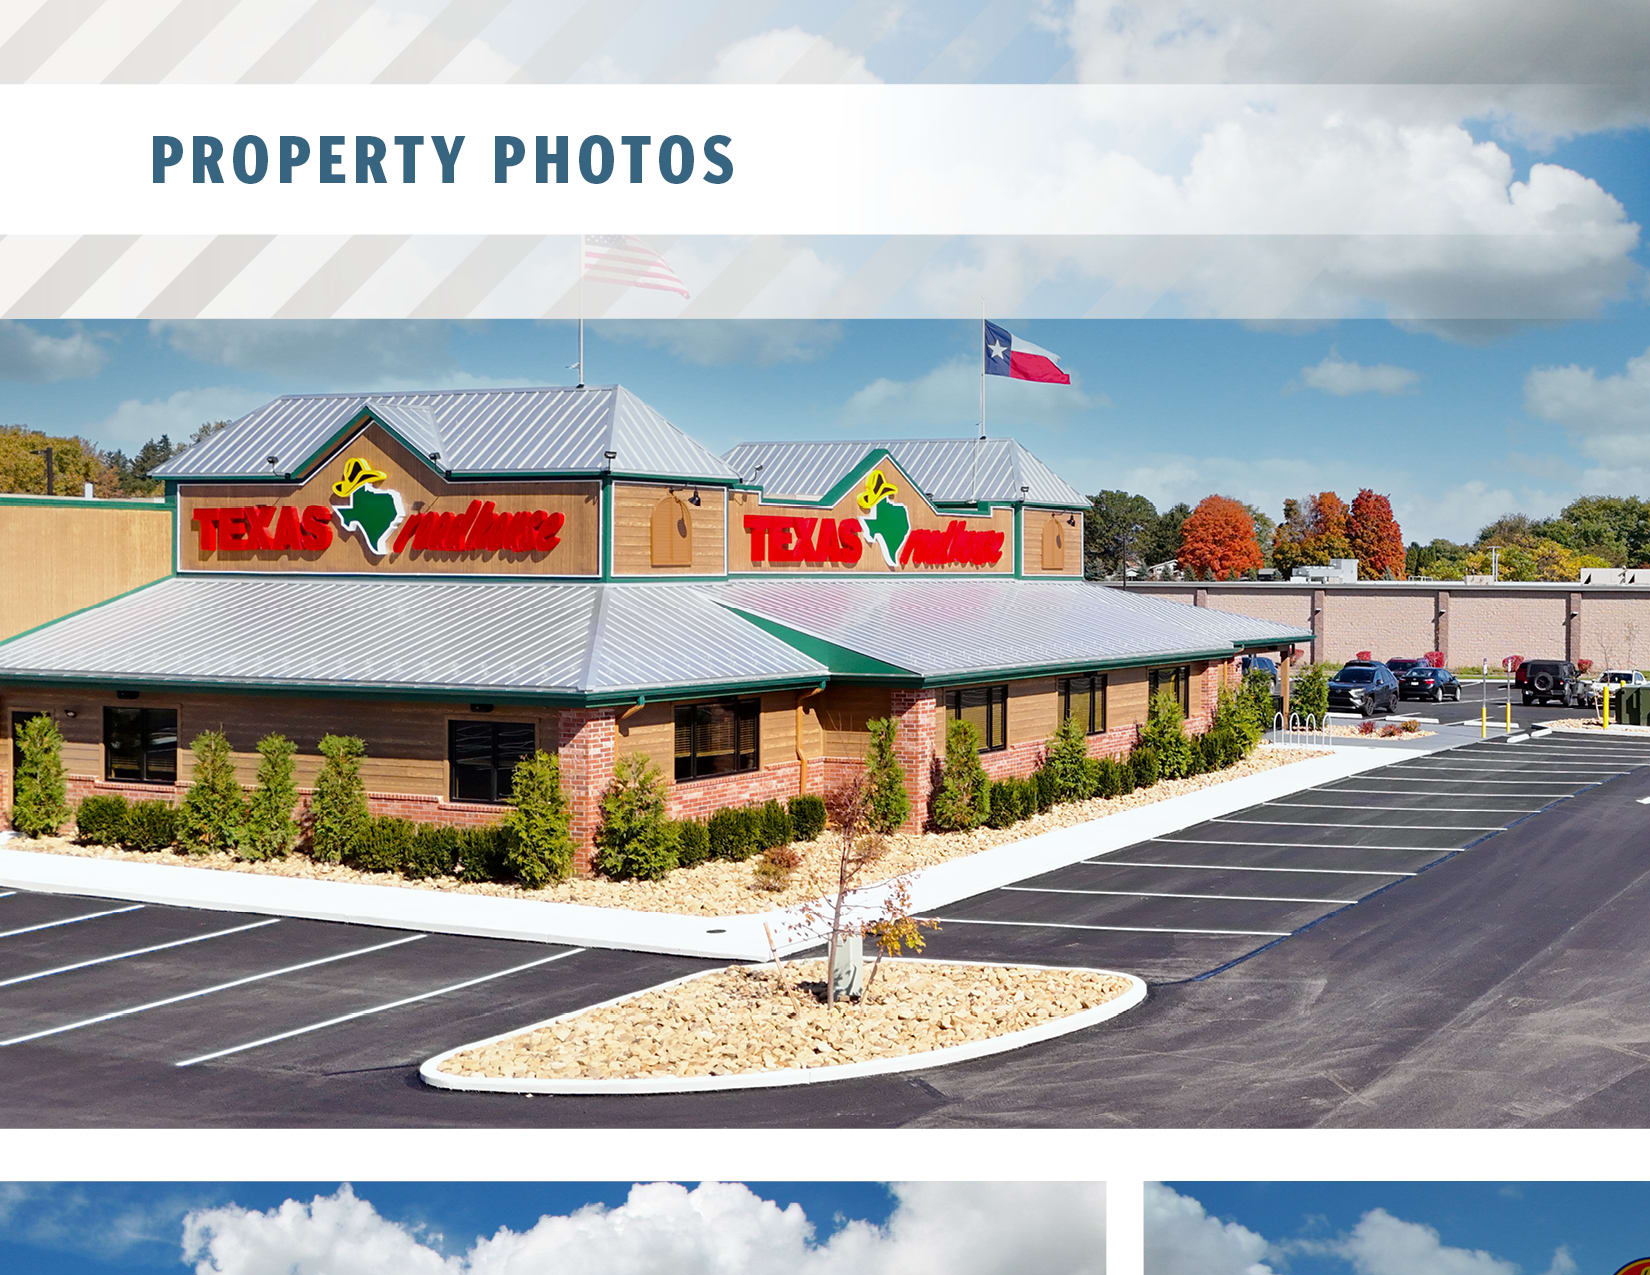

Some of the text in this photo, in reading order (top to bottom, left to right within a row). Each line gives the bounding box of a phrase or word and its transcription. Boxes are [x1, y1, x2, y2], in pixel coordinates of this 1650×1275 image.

[192, 499, 566, 555] TEXAS roadhouse
[743, 514, 863, 565] TEXAS
